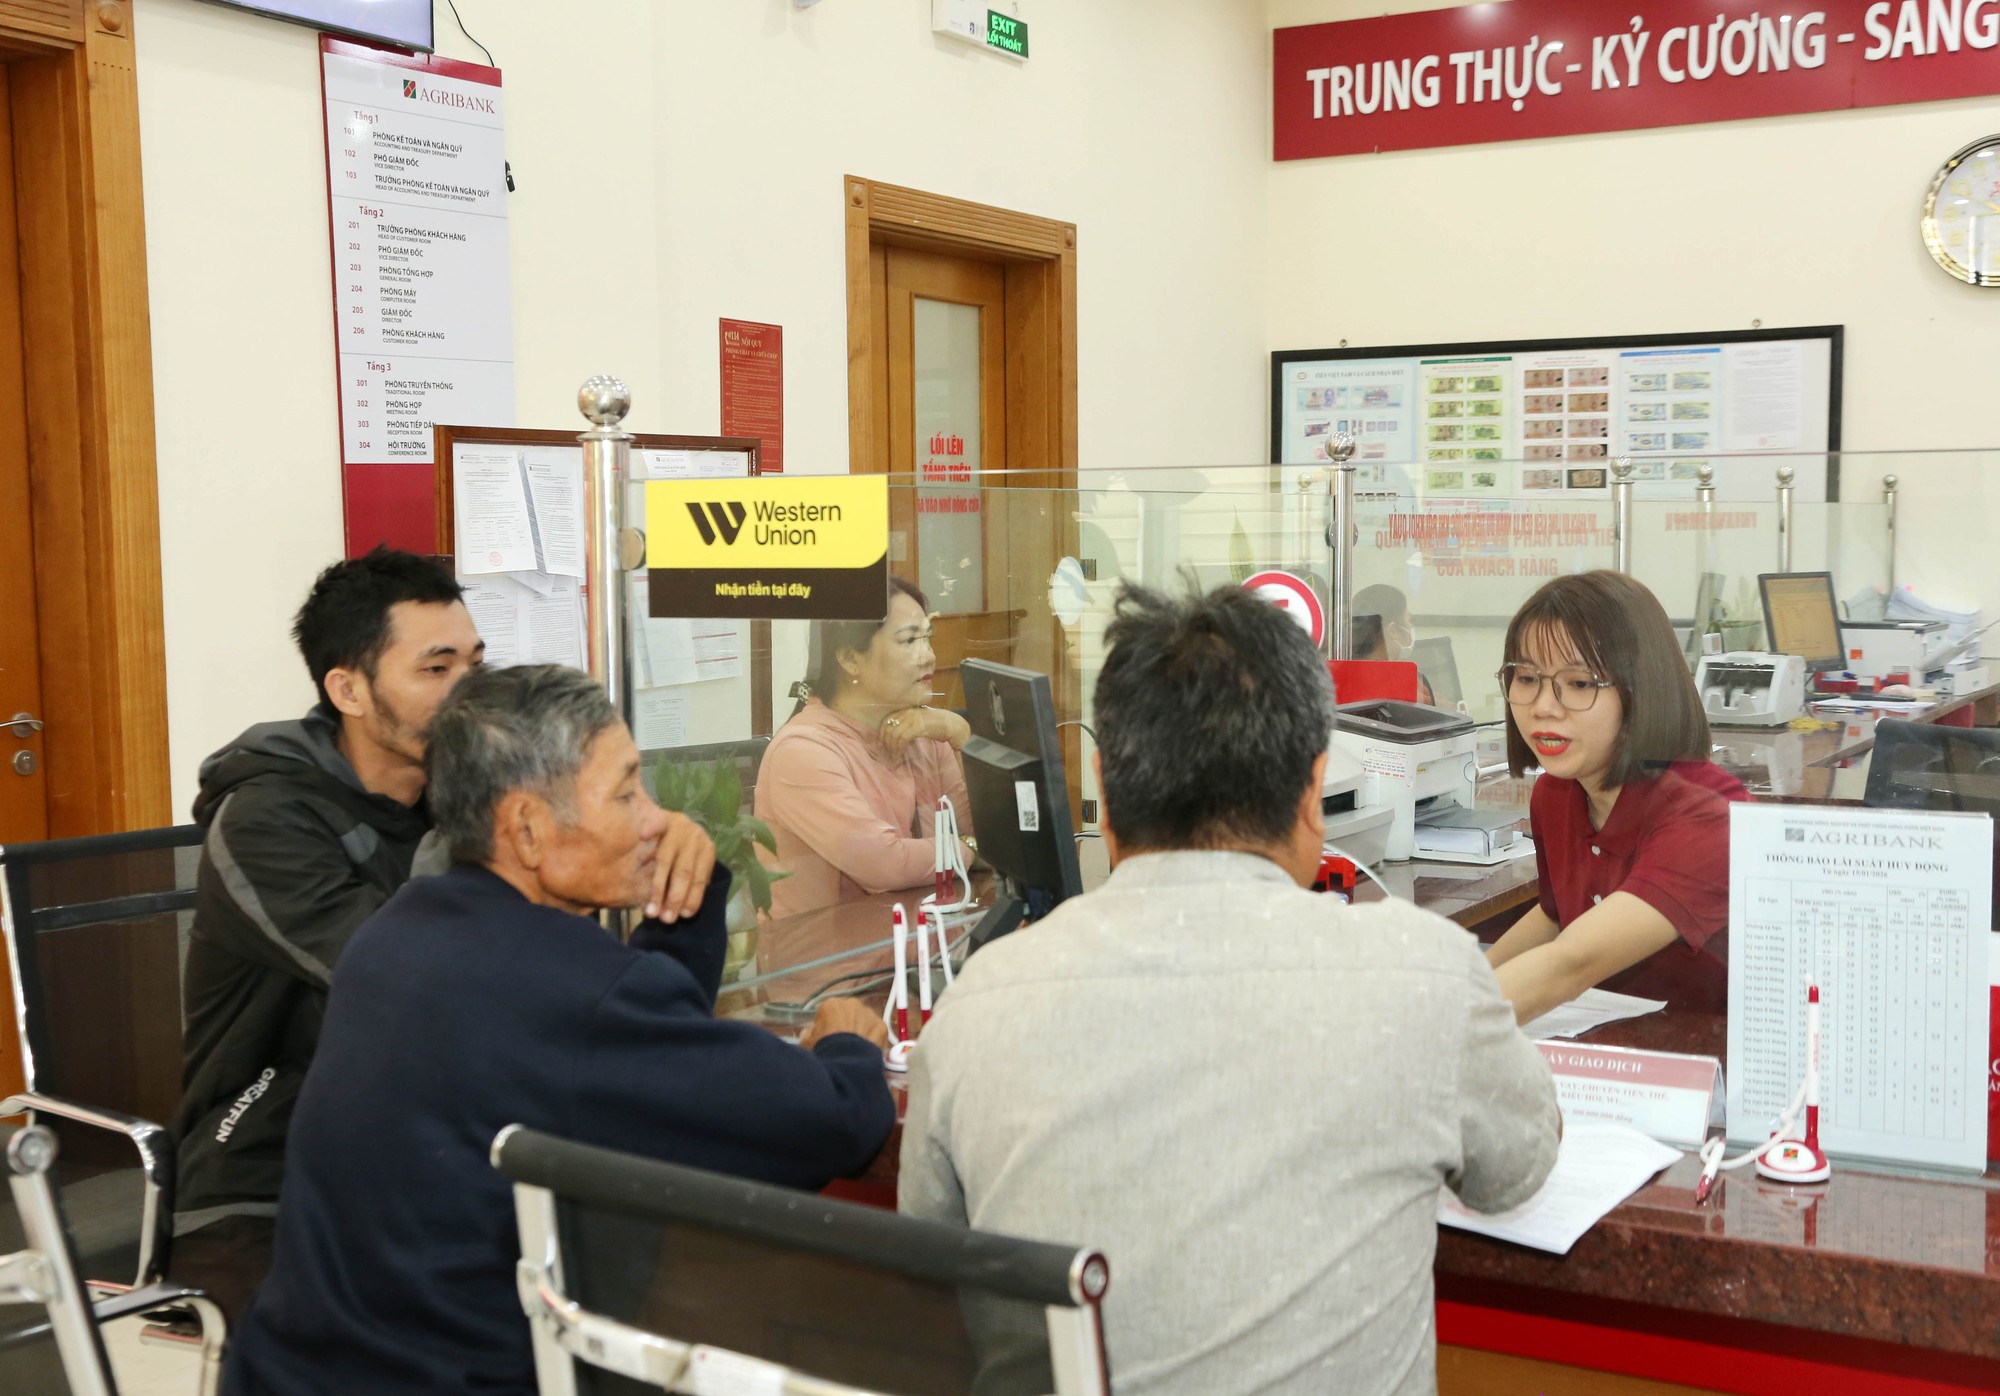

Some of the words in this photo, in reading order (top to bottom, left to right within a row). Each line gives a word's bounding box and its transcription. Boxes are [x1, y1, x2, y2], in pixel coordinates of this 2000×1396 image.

[991, 14, 1016, 36] EXIT
[999, 36, 1022, 53] THOÁT
[1306, 54, 1440, 119] TRUNG
[1449, 35, 1564, 112] THỰC
[1591, 15, 1650, 91] KỶ
[1657, 11, 1827, 83] CƯƠNG
[420, 88, 495, 114] AGRIBANK
[375, 114, 379, 123] 1
[344, 127, 354, 135] 101
[373, 131, 395, 142] PHÒNG
[396, 134, 404, 144] KẾ
[405, 136, 421, 146] TOÁN
[423, 138, 431, 148] VÀ
[432, 141, 449, 150] NGÂN
[374, 141, 401, 150] ACCOUNTING
[344, 149, 356, 158] 102
[374, 153, 387, 162] PHÓ
[388, 155, 405, 165] GIÁM
[406, 158, 419, 167] ĐỐC
[346, 171, 357, 179] 103
[402, 178, 424, 189] PHÒNG
[425, 181, 433, 190] KẾ
[434, 183, 450, 193] TOÁN
[450, 185, 458, 194] VÀ
[460, 187, 477, 196] NGÂN
[359, 205, 378, 219] Tầng
[380, 208, 384, 218] 2
[348, 221, 360, 229] 201
[404, 227, 427, 237] PHÒNG
[427, 229, 448, 239] KHÁCH
[449, 231, 466, 241] HÀNG
[349, 242, 361, 250] 202
[378, 245, 391, 253] PHÓ
[392, 246, 409, 255] GIÁM
[410, 248, 424, 257] ĐỐC
[350, 263, 361, 271] 203
[379, 265, 401, 275] PHÒNG
[380, 286, 402, 296] PHÒNG
[403, 288, 417, 297] MÁY
[352, 306, 363, 314] 205
[381, 307, 398, 317] GIÁM
[398, 308, 413, 318] ĐỐC
[353, 327, 365, 335] 206
[382, 328, 405, 337] PHÒNG
[405, 329, 427, 339] KHÁCH
[427, 330, 445, 340] HÀNG
[367, 360, 386, 373] Tầng
[386, 363, 391, 372] 3
[356, 379, 368, 387] 301
[385, 380, 407, 389] PHÒNG
[386, 400, 408, 409] PHÒNG
[358, 420, 369, 428] 303
[386, 420, 409, 429] PHÒNG
[359, 441, 370, 449] 304
[930, 431, 944, 455] LỐI
[947, 434, 963, 455] LÊN
[754, 500, 842, 522] Western
[754, 524, 816, 546] Union
[715, 583, 746, 599] Nhận
[748, 580, 770, 597] tiền
[771, 582, 787, 599] tại
[788, 582, 811, 599] đây
[1810, 830, 1945, 851] AGRIBANK
[1765, 852, 1804, 864] THÔNG
[1807, 854, 1830, 865] BÁO
[1887, 859, 1910, 870] HUY
[1569, 1056, 1603, 1069] GIAO
[1607, 1059, 1642, 1074] DỊCH
[215, 1067, 276, 1142] GREATFUN
